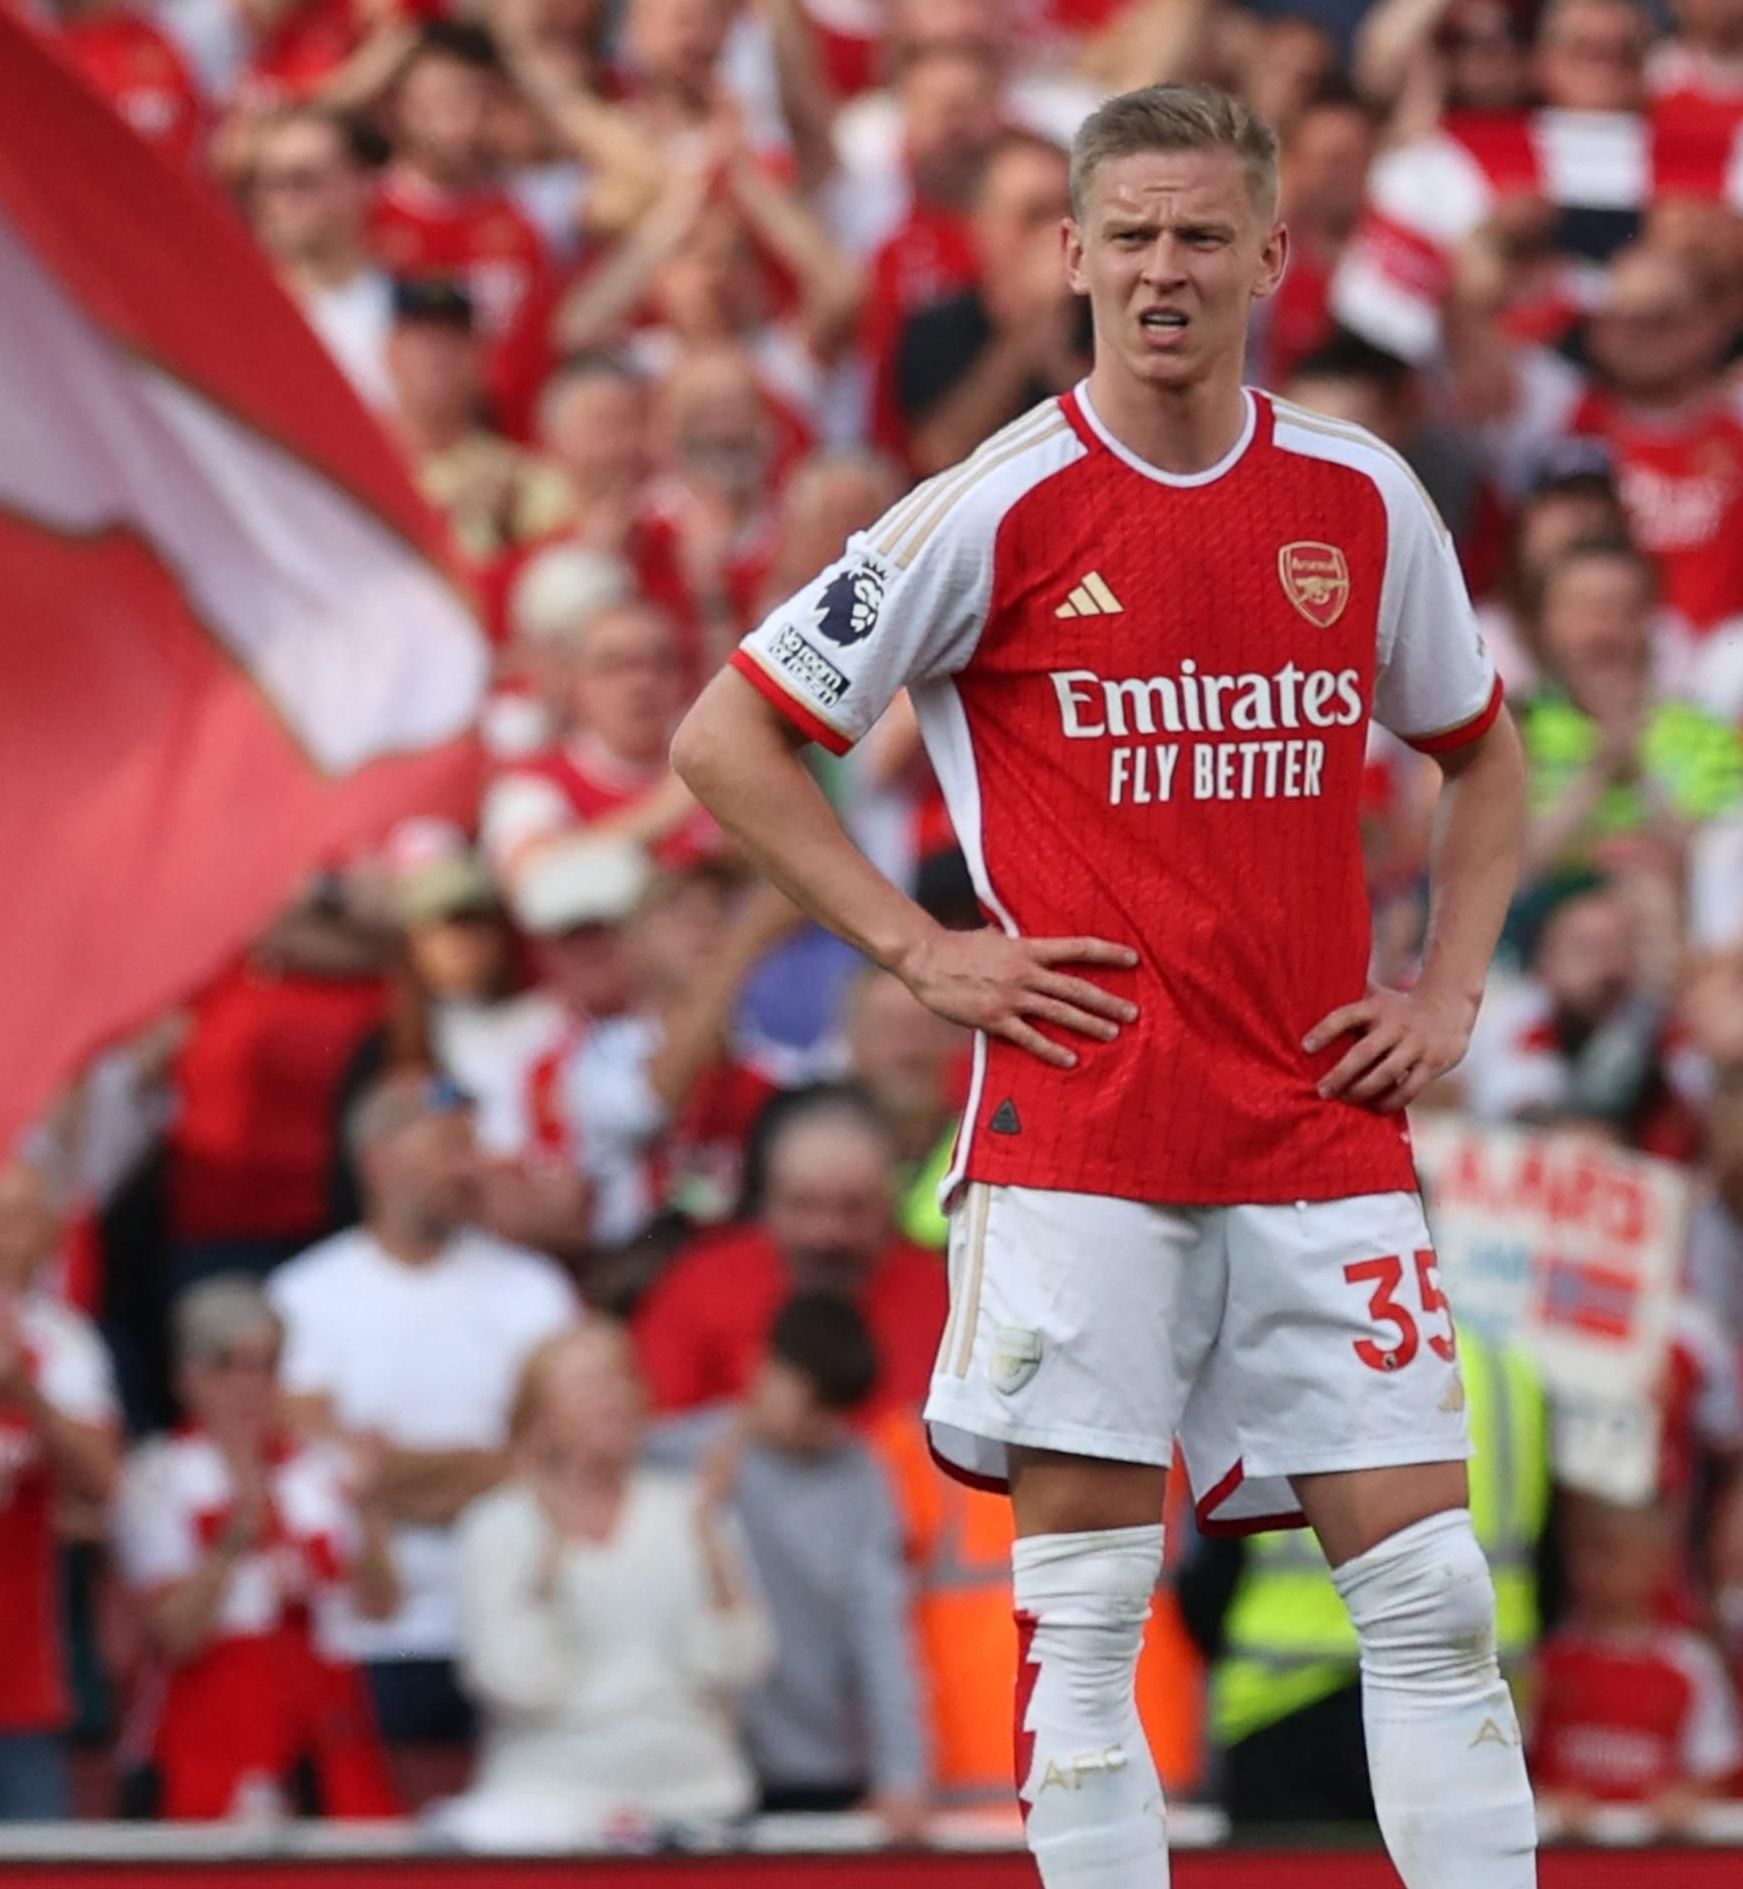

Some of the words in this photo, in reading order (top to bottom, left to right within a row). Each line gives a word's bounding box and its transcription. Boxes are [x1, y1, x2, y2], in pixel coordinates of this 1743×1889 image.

[794, 644, 844, 691] room
[1049, 658, 1363, 738] Emirates
[1110, 744, 1179, 805] FLY
[1193, 739, 1325, 800] BETTER
[1343, 1249, 1455, 1373] 35
